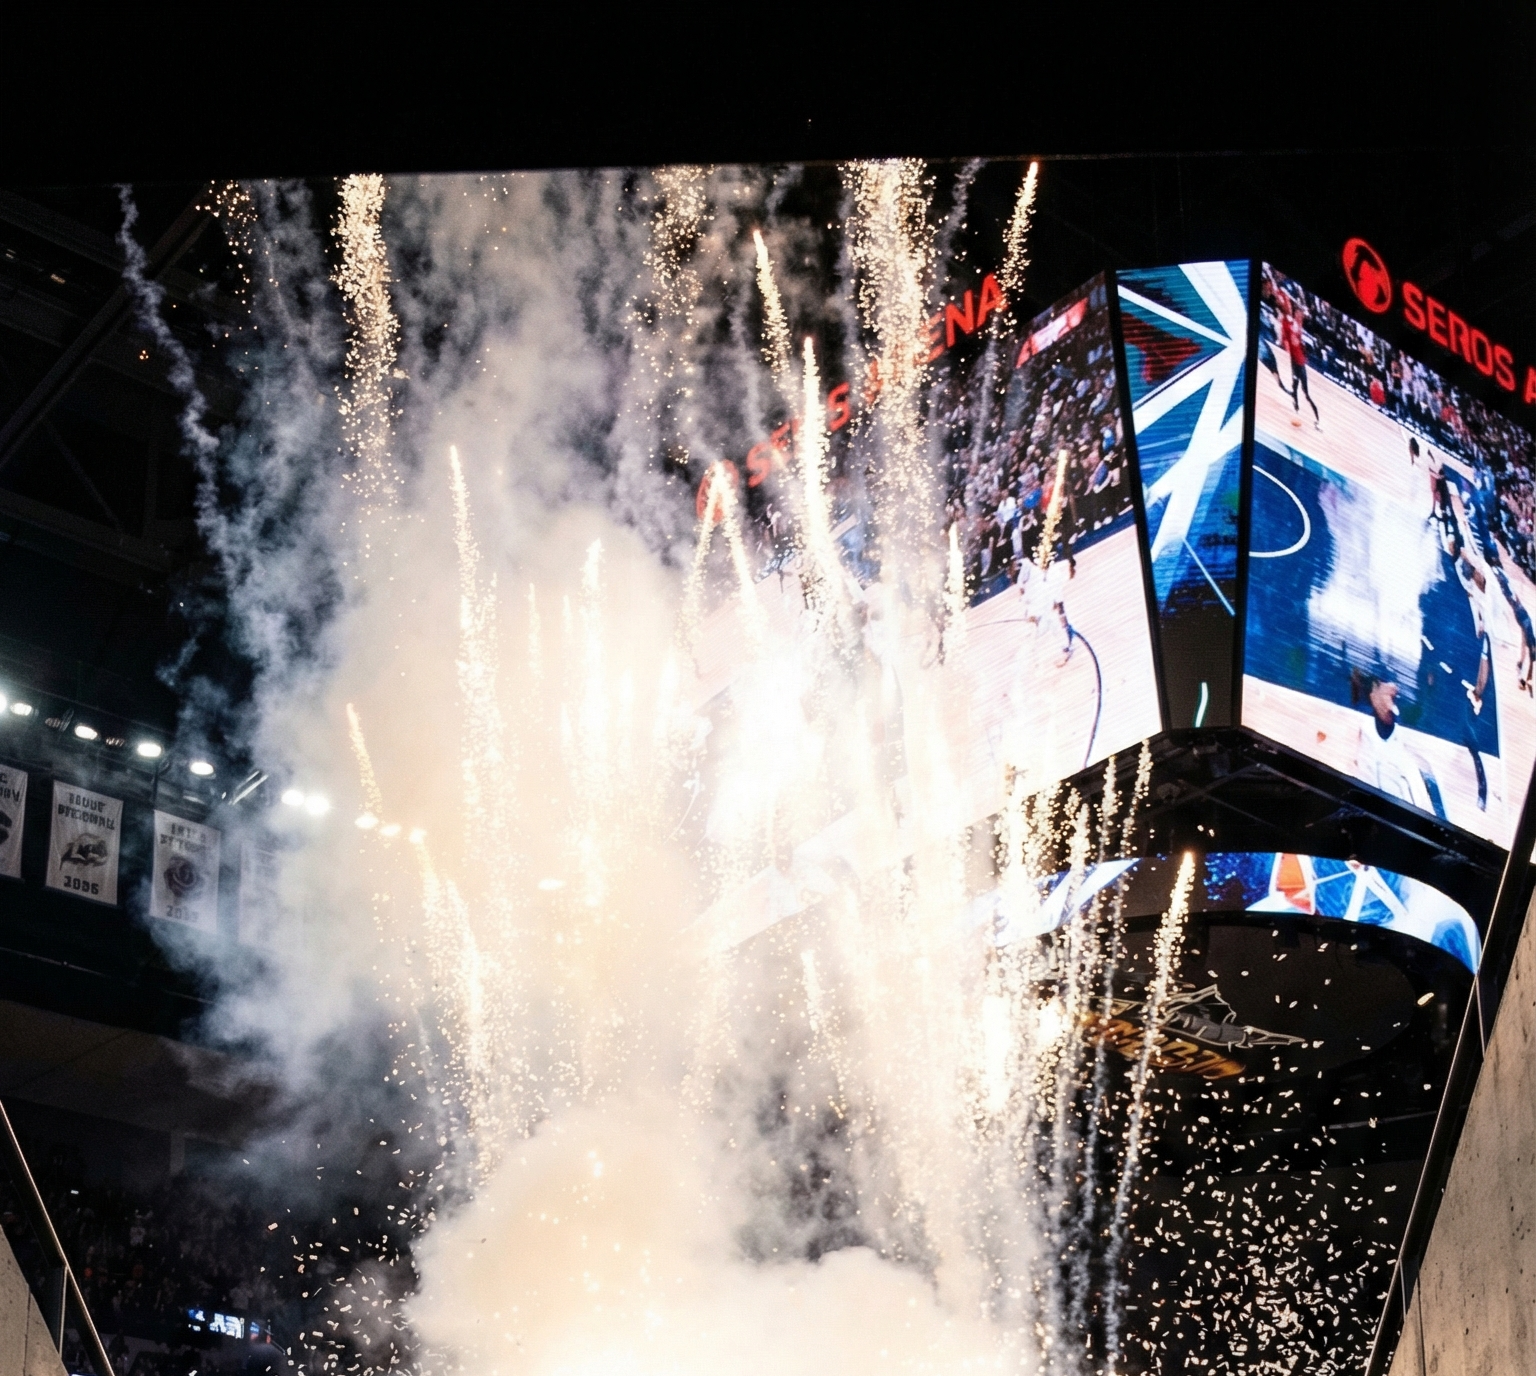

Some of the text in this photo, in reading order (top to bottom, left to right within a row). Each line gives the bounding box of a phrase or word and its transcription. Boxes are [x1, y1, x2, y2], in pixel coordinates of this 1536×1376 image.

[746, 272, 1008, 489] SES ENA
[1402, 281, 1516, 392] SEROS
